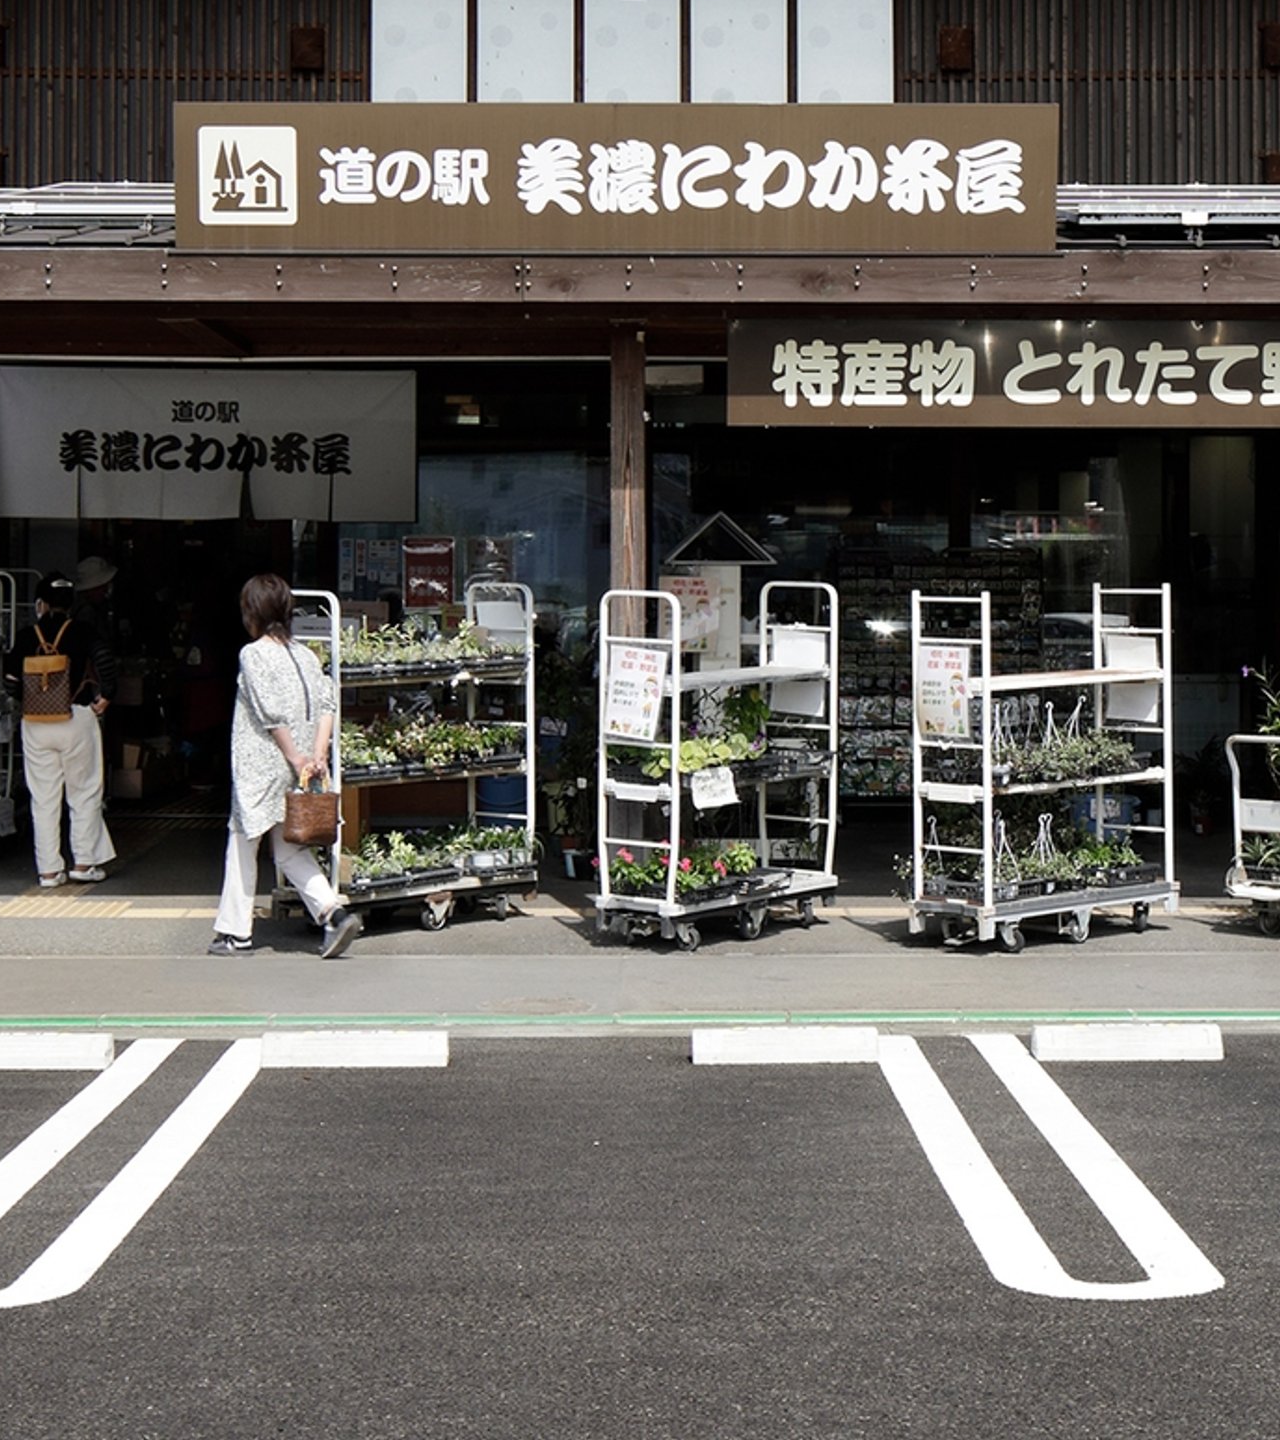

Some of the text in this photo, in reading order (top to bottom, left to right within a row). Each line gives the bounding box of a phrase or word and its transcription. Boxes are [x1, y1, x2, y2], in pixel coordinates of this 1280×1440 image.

[319, 138, 1026, 215] 道の駅 美濃にわか茶屋
[772, 340, 975, 407] 特産物
[171, 400, 240, 423] 道の駅
[59, 429, 352, 474] 美濃にわか茶屋
